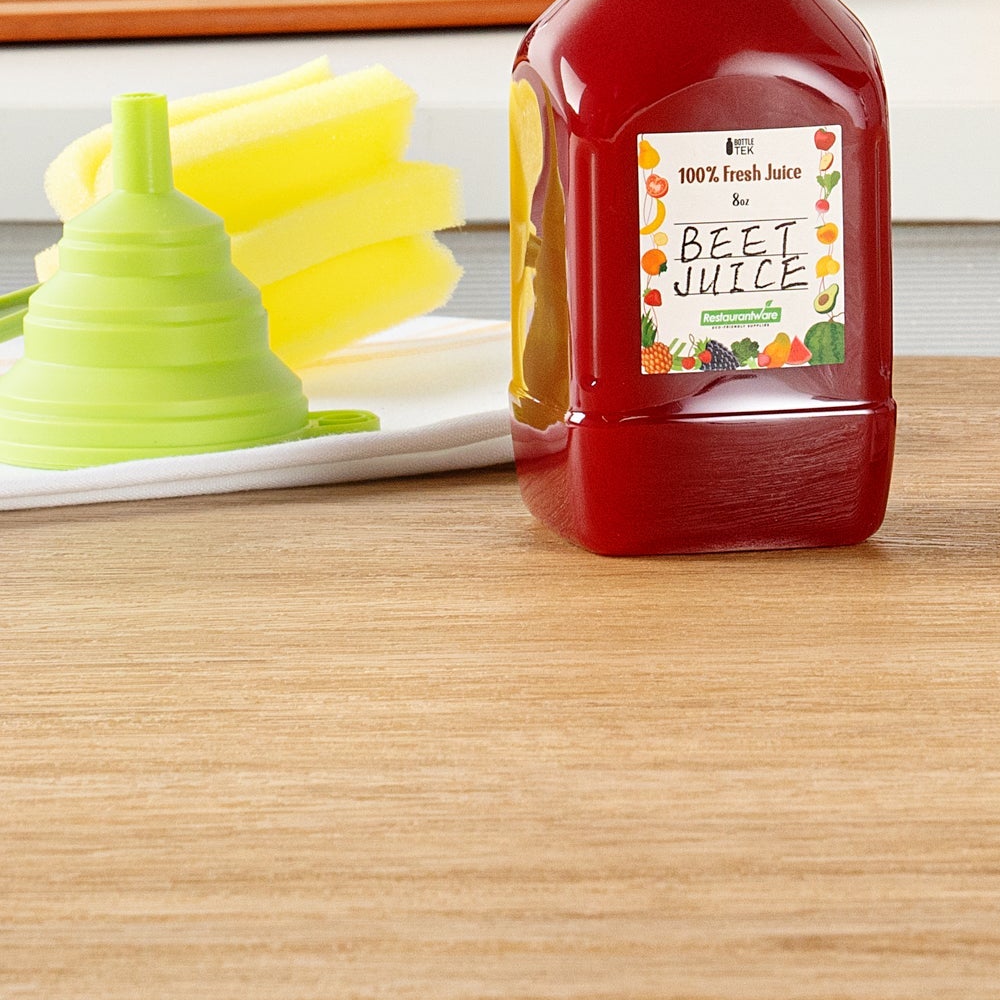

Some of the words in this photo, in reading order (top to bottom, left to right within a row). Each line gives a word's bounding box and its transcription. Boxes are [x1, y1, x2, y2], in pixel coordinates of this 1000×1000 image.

[734, 138, 754, 146] BOTTLE
[735, 146, 754, 155] TEK
[678, 166, 720, 184] 100%
[723, 164, 761, 182] Fresh
[765, 163, 802, 181] Juice
[732, 193, 750, 207] 8oz
[681, 221, 797, 263] BEET
[673, 256, 809, 297] JUICE
[703, 309, 778, 323] Restaurantware
